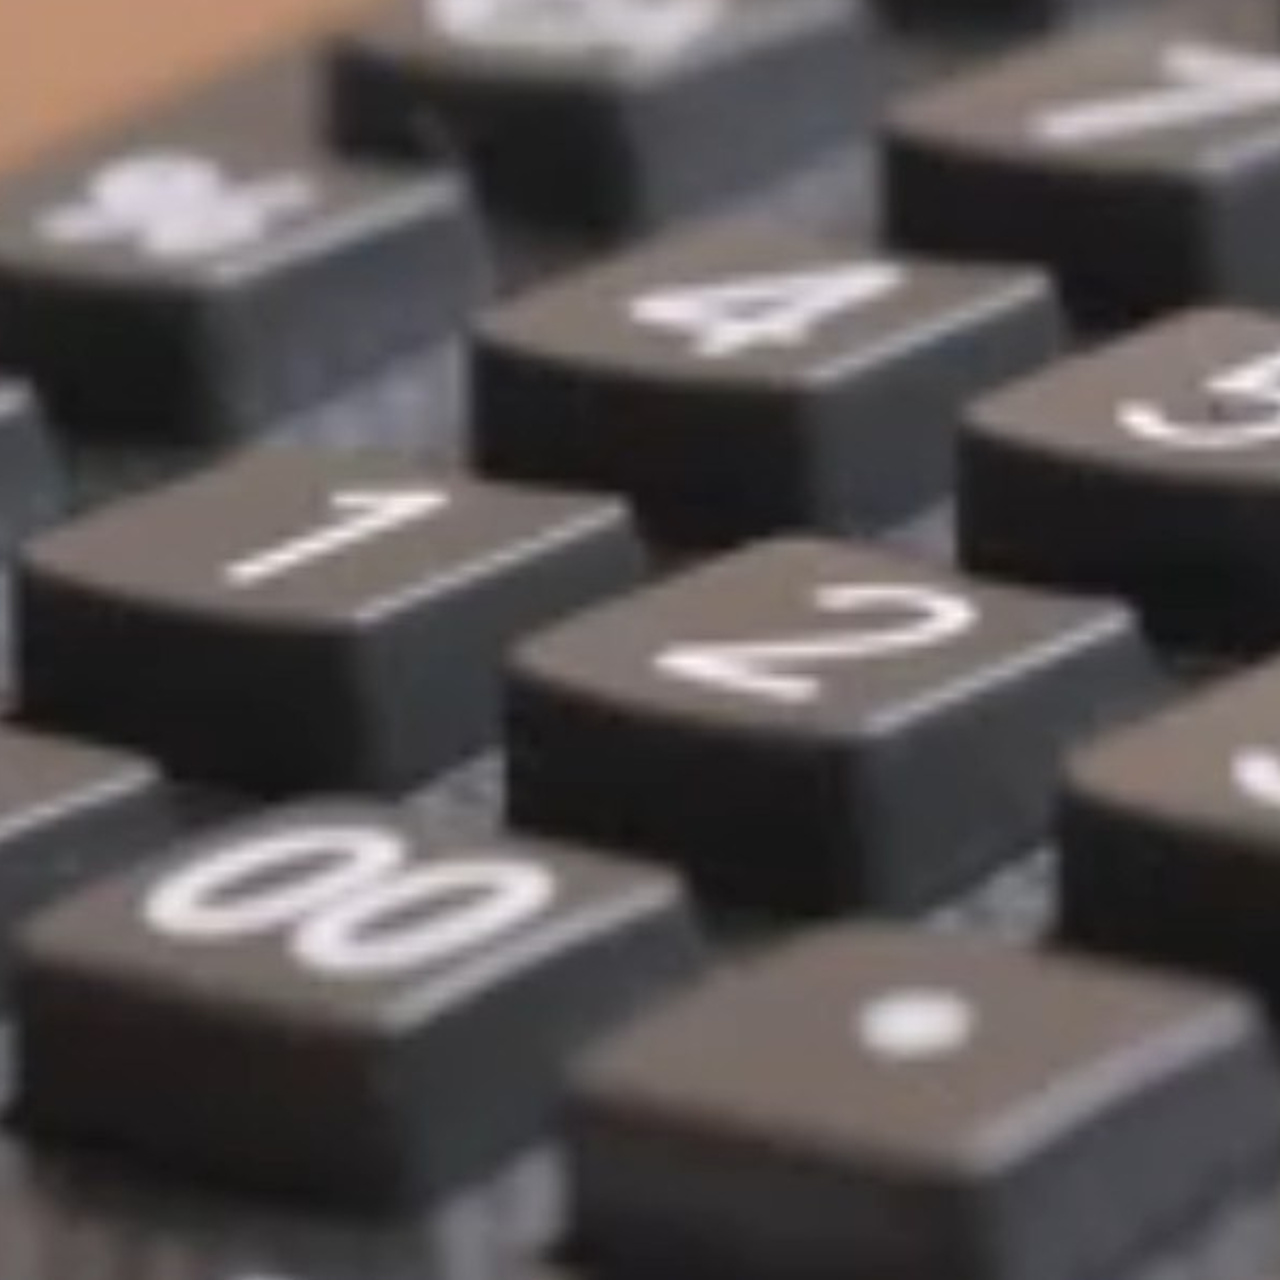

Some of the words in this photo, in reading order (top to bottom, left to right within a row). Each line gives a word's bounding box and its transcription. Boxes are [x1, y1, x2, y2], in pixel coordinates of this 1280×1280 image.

[628, 258, 904, 358] 4
[222, 488, 450, 586] 1
[652, 584, 980, 702] 2
[142, 824, 556, 972] 00
